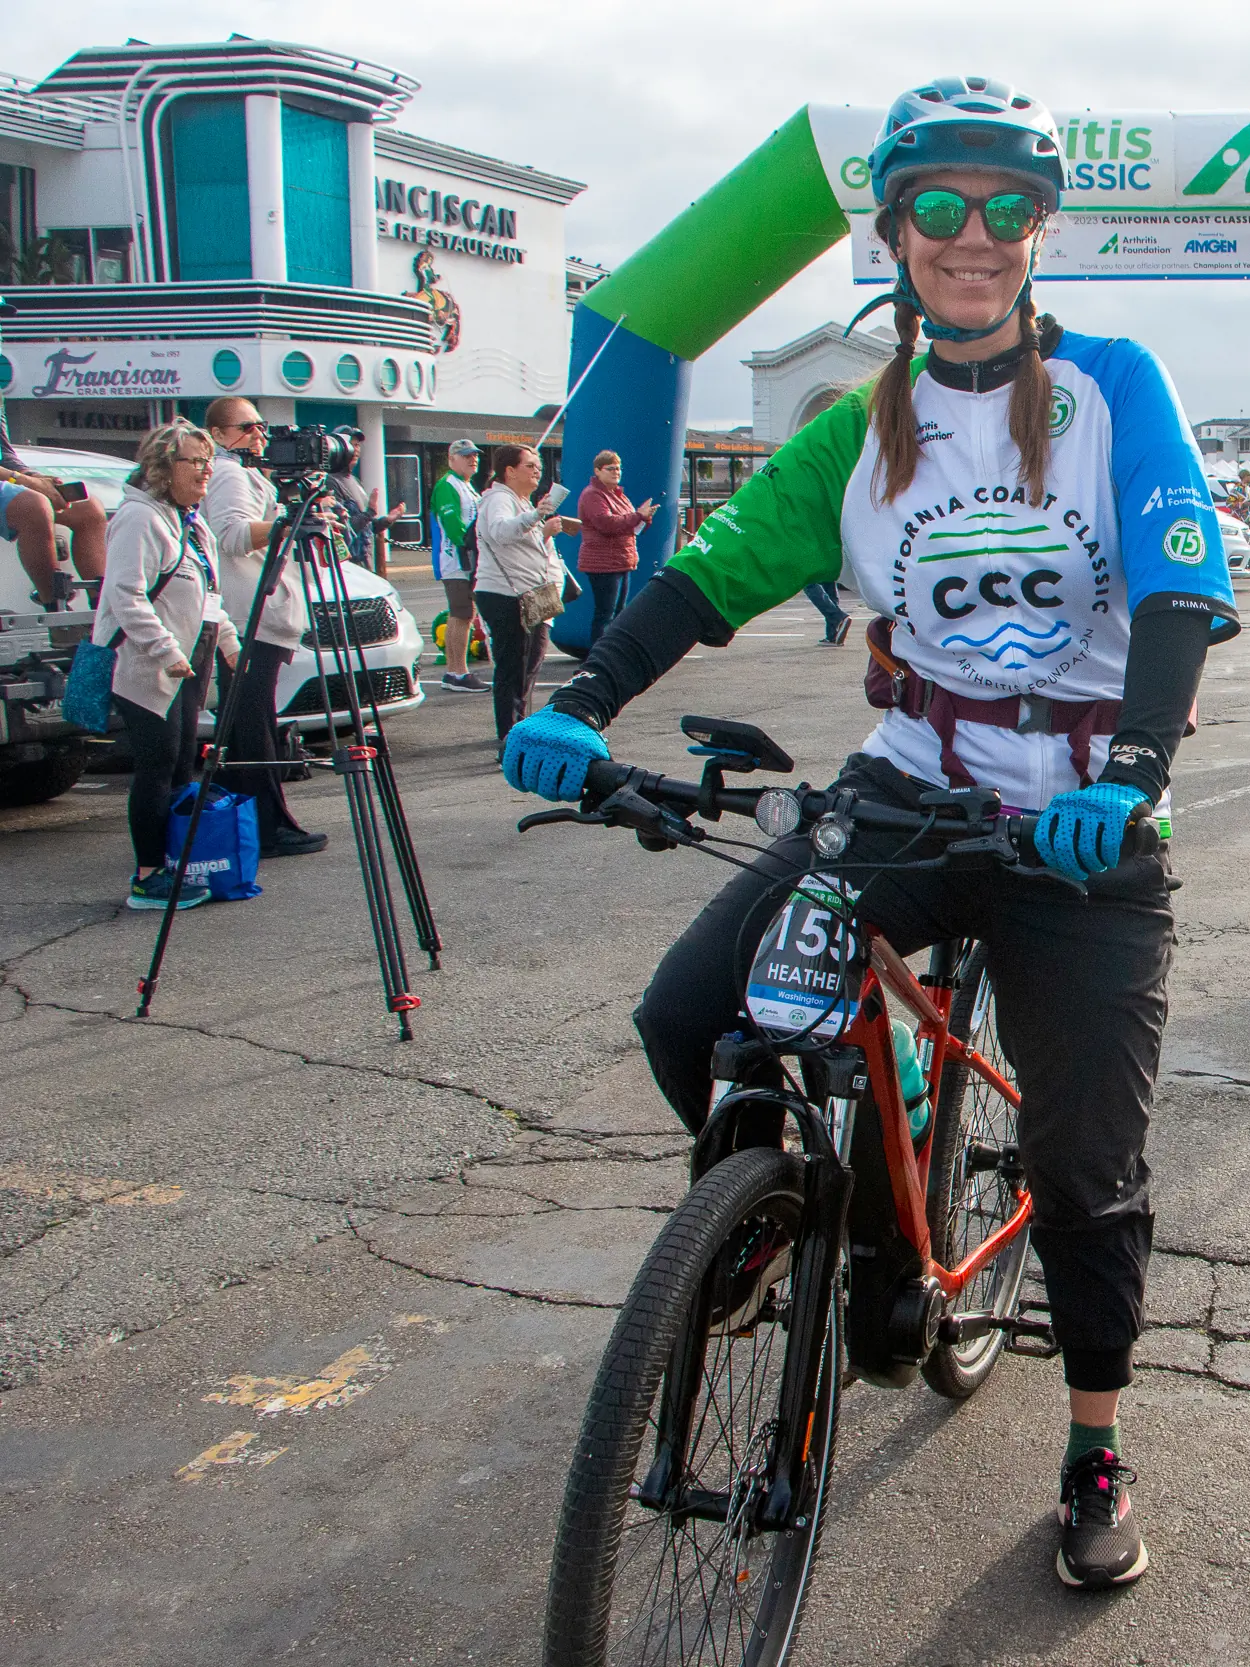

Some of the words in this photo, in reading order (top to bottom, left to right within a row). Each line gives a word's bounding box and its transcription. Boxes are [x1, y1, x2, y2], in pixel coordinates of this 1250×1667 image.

[1067, 163, 1152, 190] SSIC
[375, 176, 516, 239] ANCISCAN
[1074, 215, 1099, 225] 2023
[1101, 215, 1170, 225] CALIFORNIA
[1173, 215, 1211, 225] COAST
[395, 222, 528, 264] RESTAURANT
[1122, 236, 1157, 245] Arthritis
[1122, 246, 1170, 254] Foundation
[1184, 239, 1237, 253] AMGEN
[1193, 262, 1231, 270] Champions
[1234, 261, 1242, 269] of
[31, 347, 181, 397] Franciscan
[77, 387, 106, 396] CRAB
[110, 386, 181, 396] RESTAURANT
[1167, 486, 1202, 498] Arthritis
[1170, 531, 1199, 558] 75
[893, 495, 966, 636] CALIFORNIA
[973, 485, 1058, 511] COAT
[1062, 509, 1111, 615] CLASSIC
[932, 568, 1065, 620] CCC
[1171, 599, 1210, 611] PRIMAL
[956, 656, 1021, 693] ARTHRITIS
[767, 962, 841, 992] HEATHE
[778, 989, 824, 1006] Washington
